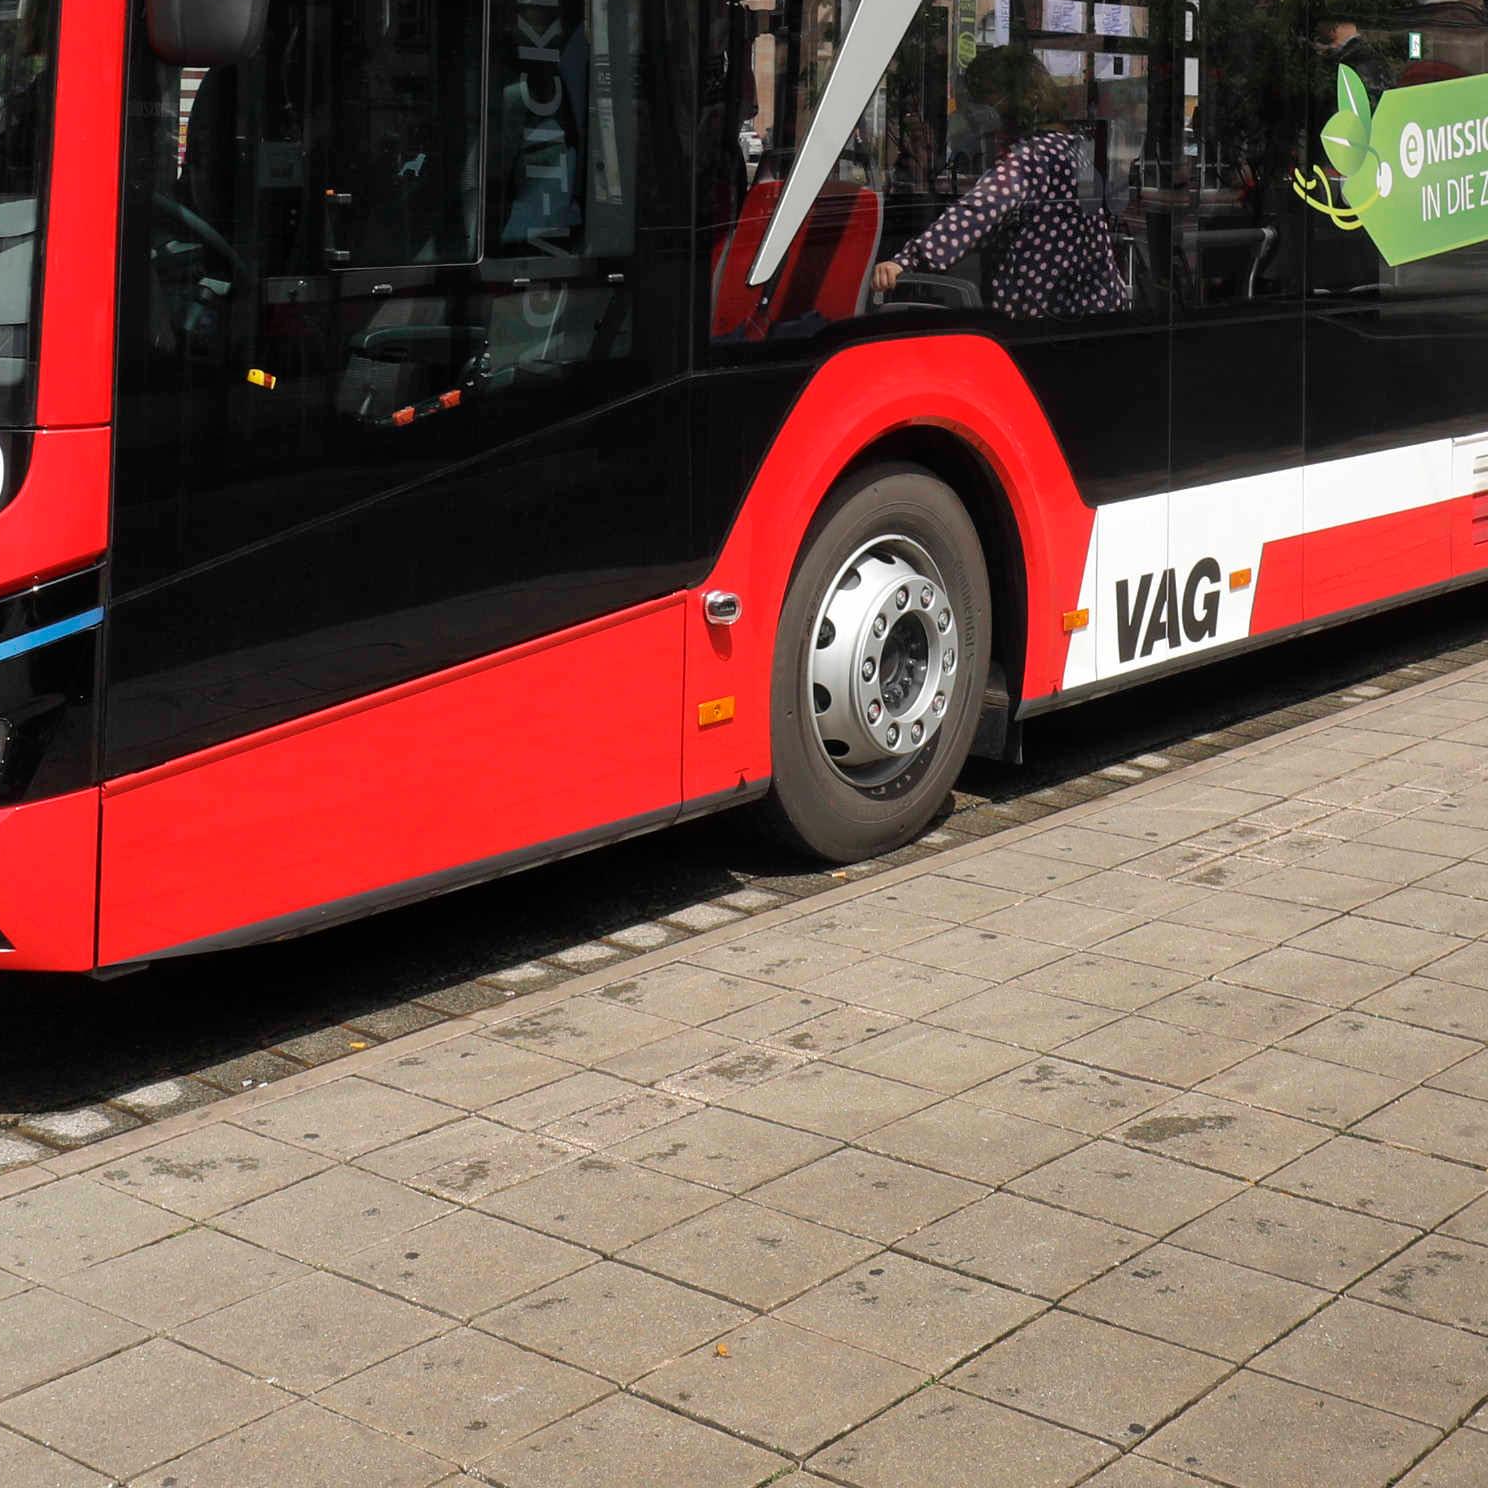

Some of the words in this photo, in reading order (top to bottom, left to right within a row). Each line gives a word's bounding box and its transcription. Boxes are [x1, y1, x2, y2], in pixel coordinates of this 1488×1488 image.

[1421, 183, 1441, 222] IN
[1447, 174, 1475, 216] DIE
[1115, 557, 1222, 664] VAG
